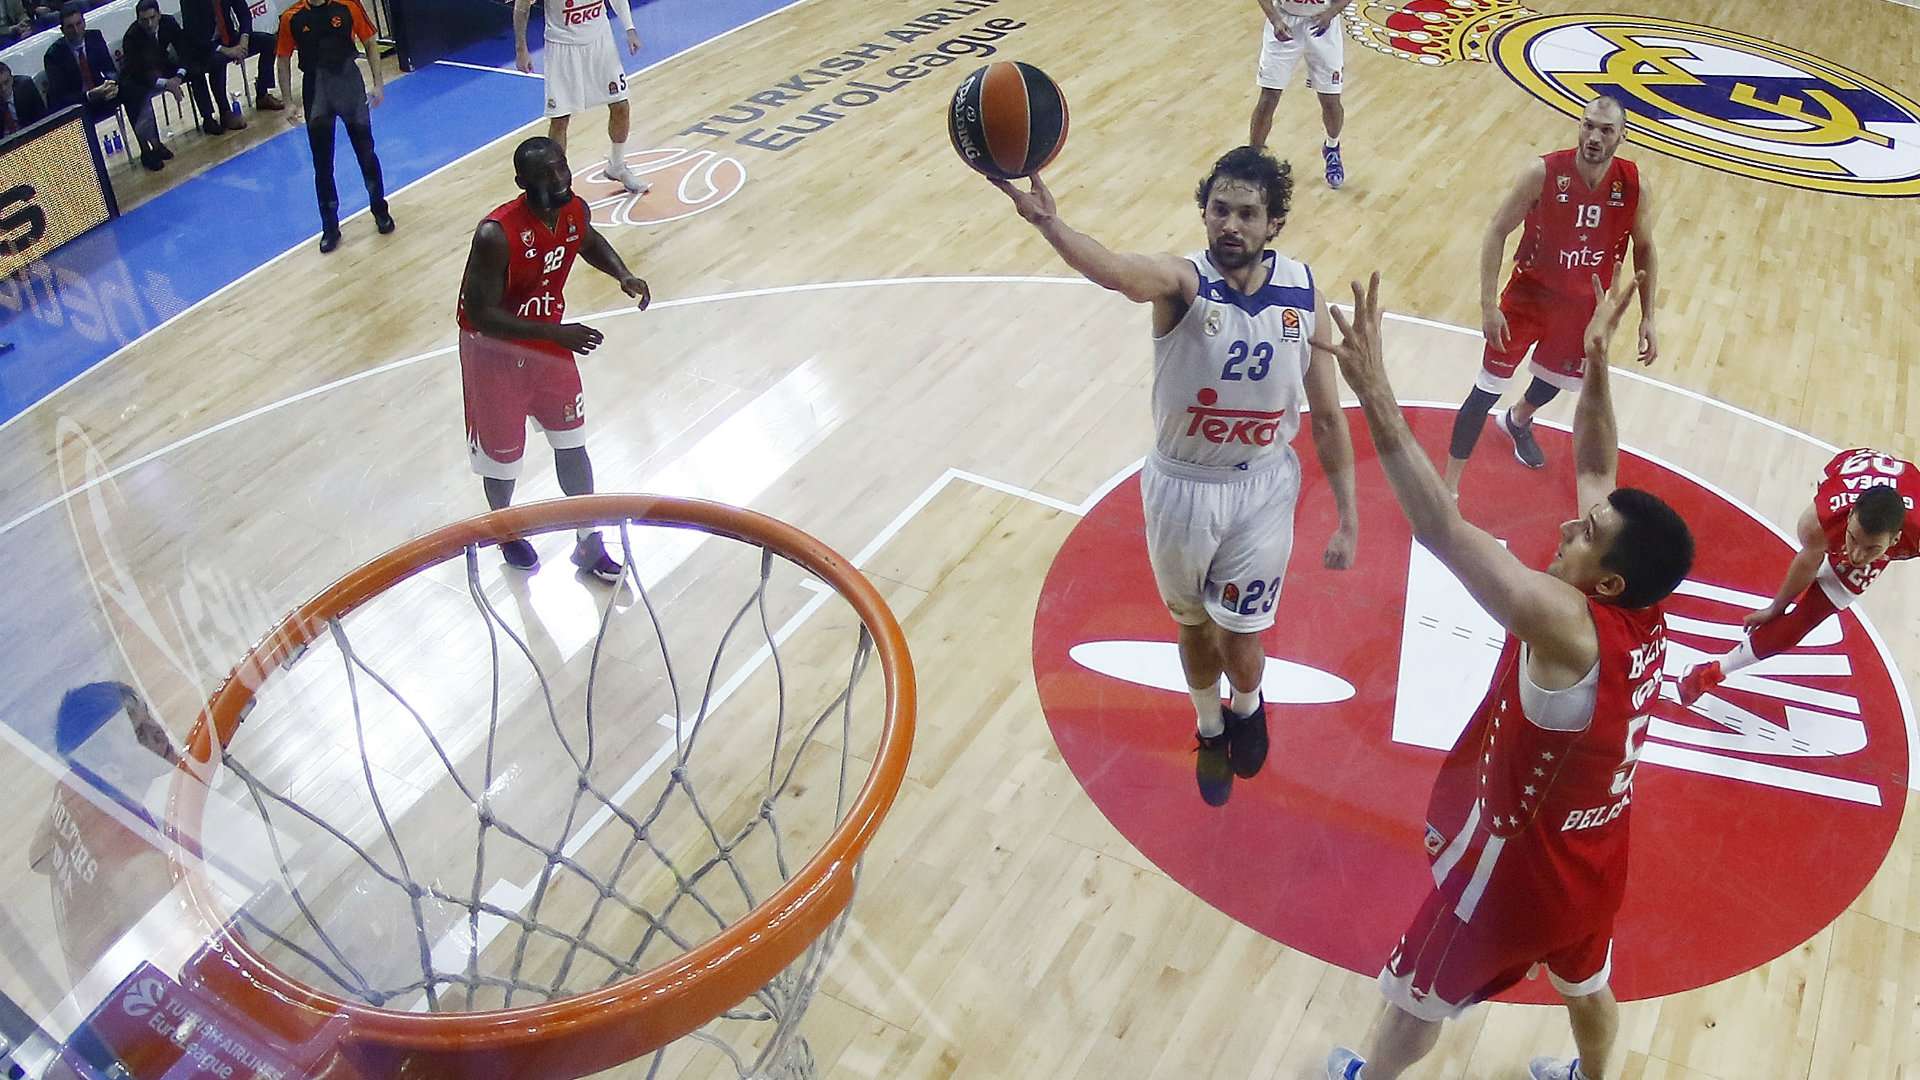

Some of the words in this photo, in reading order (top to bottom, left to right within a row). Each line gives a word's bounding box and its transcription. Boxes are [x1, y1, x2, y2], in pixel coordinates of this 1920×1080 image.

[562, 1, 603, 26] Teka
[680, 43, 896, 138] TURKISH
[884, 0, 999, 43] AIRLI
[736, 18, 1027, 151] EuroLeague
[1575, 204, 1601, 228] 19
[543, 246, 566, 274] 22
[1559, 246, 1605, 270] mts
[1220, 340, 1274, 381] 23
[1186, 405, 1286, 447] Teka
[1239, 576, 1281, 616] 23
